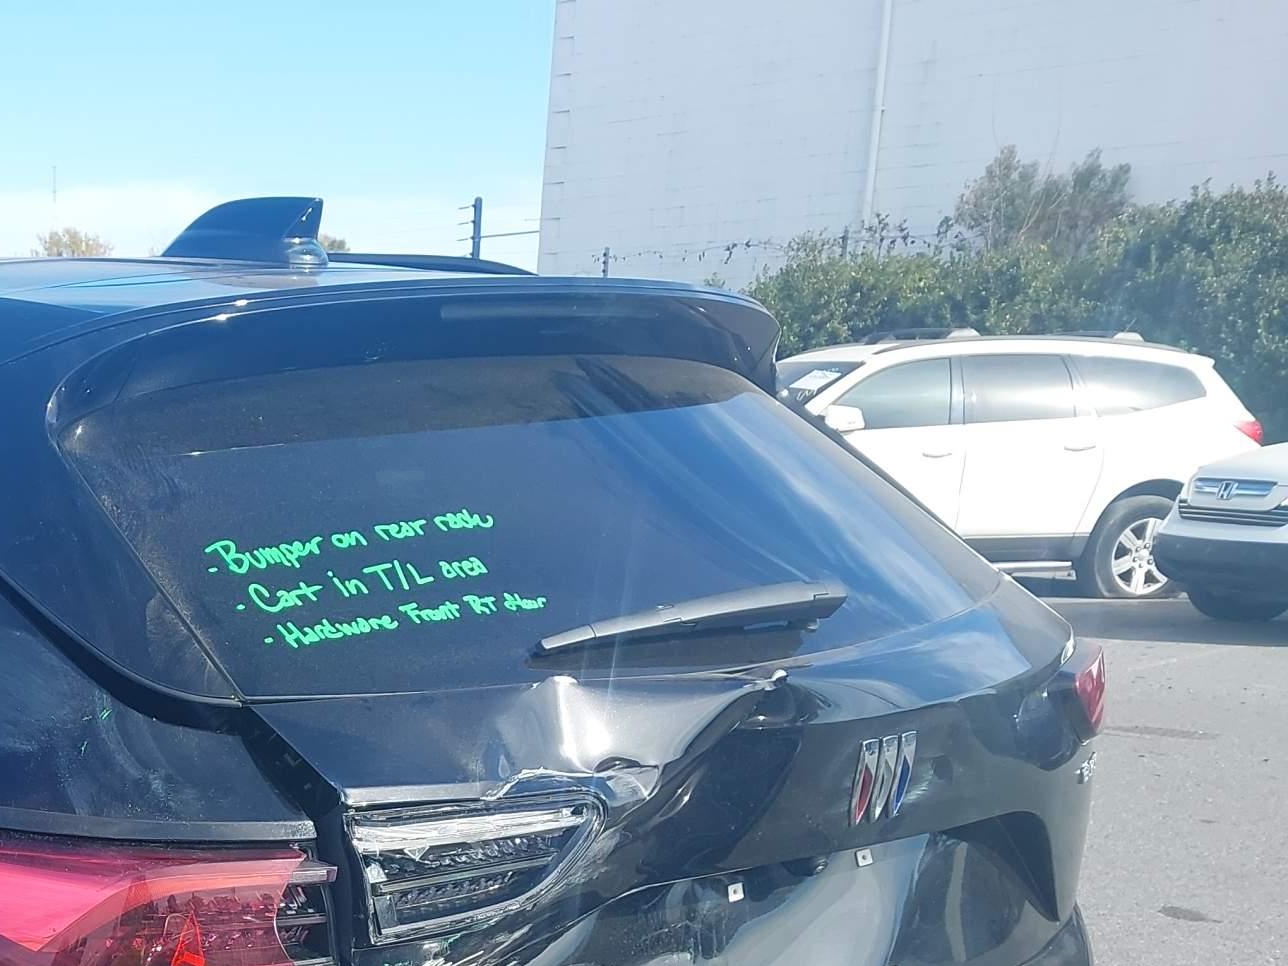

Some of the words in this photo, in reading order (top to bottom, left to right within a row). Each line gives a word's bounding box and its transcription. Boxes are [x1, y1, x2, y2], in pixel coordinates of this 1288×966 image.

[205, 537, 323, 574] Bumper
[331, 531, 367, 549] on
[374, 519, 427, 540] rear
[327, 571, 368, 597] in
[363, 559, 434, 591] T/L
[439, 556, 489, 579] area
[276, 614, 399, 648] Hardware
[398, 601, 460, 624] Front
